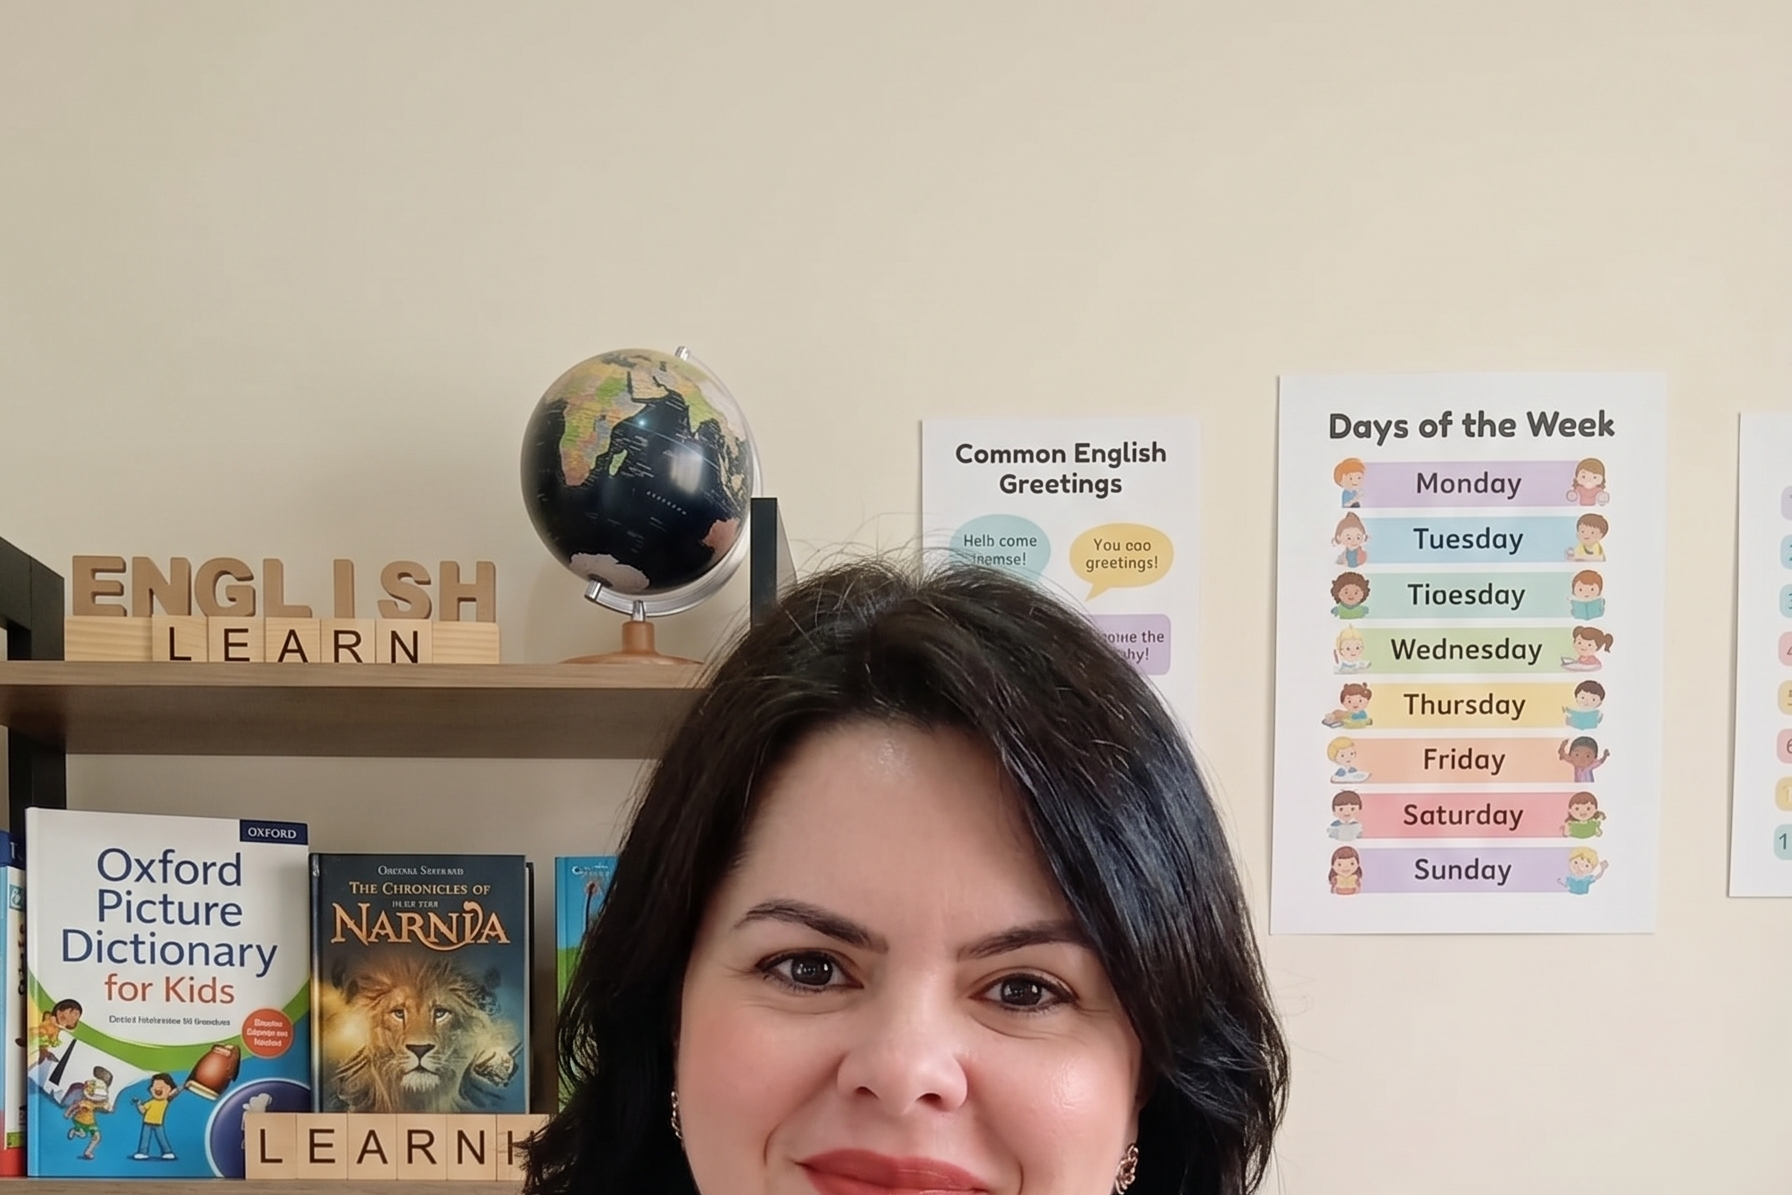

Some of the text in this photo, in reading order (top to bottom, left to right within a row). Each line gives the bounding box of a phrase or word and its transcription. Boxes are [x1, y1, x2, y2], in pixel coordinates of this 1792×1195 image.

[1330, 410, 1615, 446] Days of the Week
[956, 441, 1167, 469] Common English
[1000, 471, 1123, 499] Greetings
[1416, 471, 1522, 500] Monday
[999, 537, 1037, 547] come
[1093, 538, 1121, 551] You
[1413, 527, 1524, 556] Tuesday
[1085, 555, 1158, 573] greetings!
[72, 555, 497, 623] ENGLISH
[168, 626, 419, 663] LEARN
[1142, 630, 1165, 643] the
[1391, 637, 1543, 666] Wednesday
[1404, 692, 1526, 721] Thursday
[1424, 747, 1506, 776] Friday
[1403, 802, 1524, 831] Saturday
[247, 827, 297, 840] OXFORD
[97, 848, 242, 886] Oxford
[1415, 857, 1512, 886] Sunday
[349, 881, 491, 896] THE CHRONICLES OF
[98, 888, 243, 927] Picture
[331, 901, 511, 951] NARNIA
[62, 928, 278, 978] Dictionary
[104, 973, 235, 1004] for Kids
